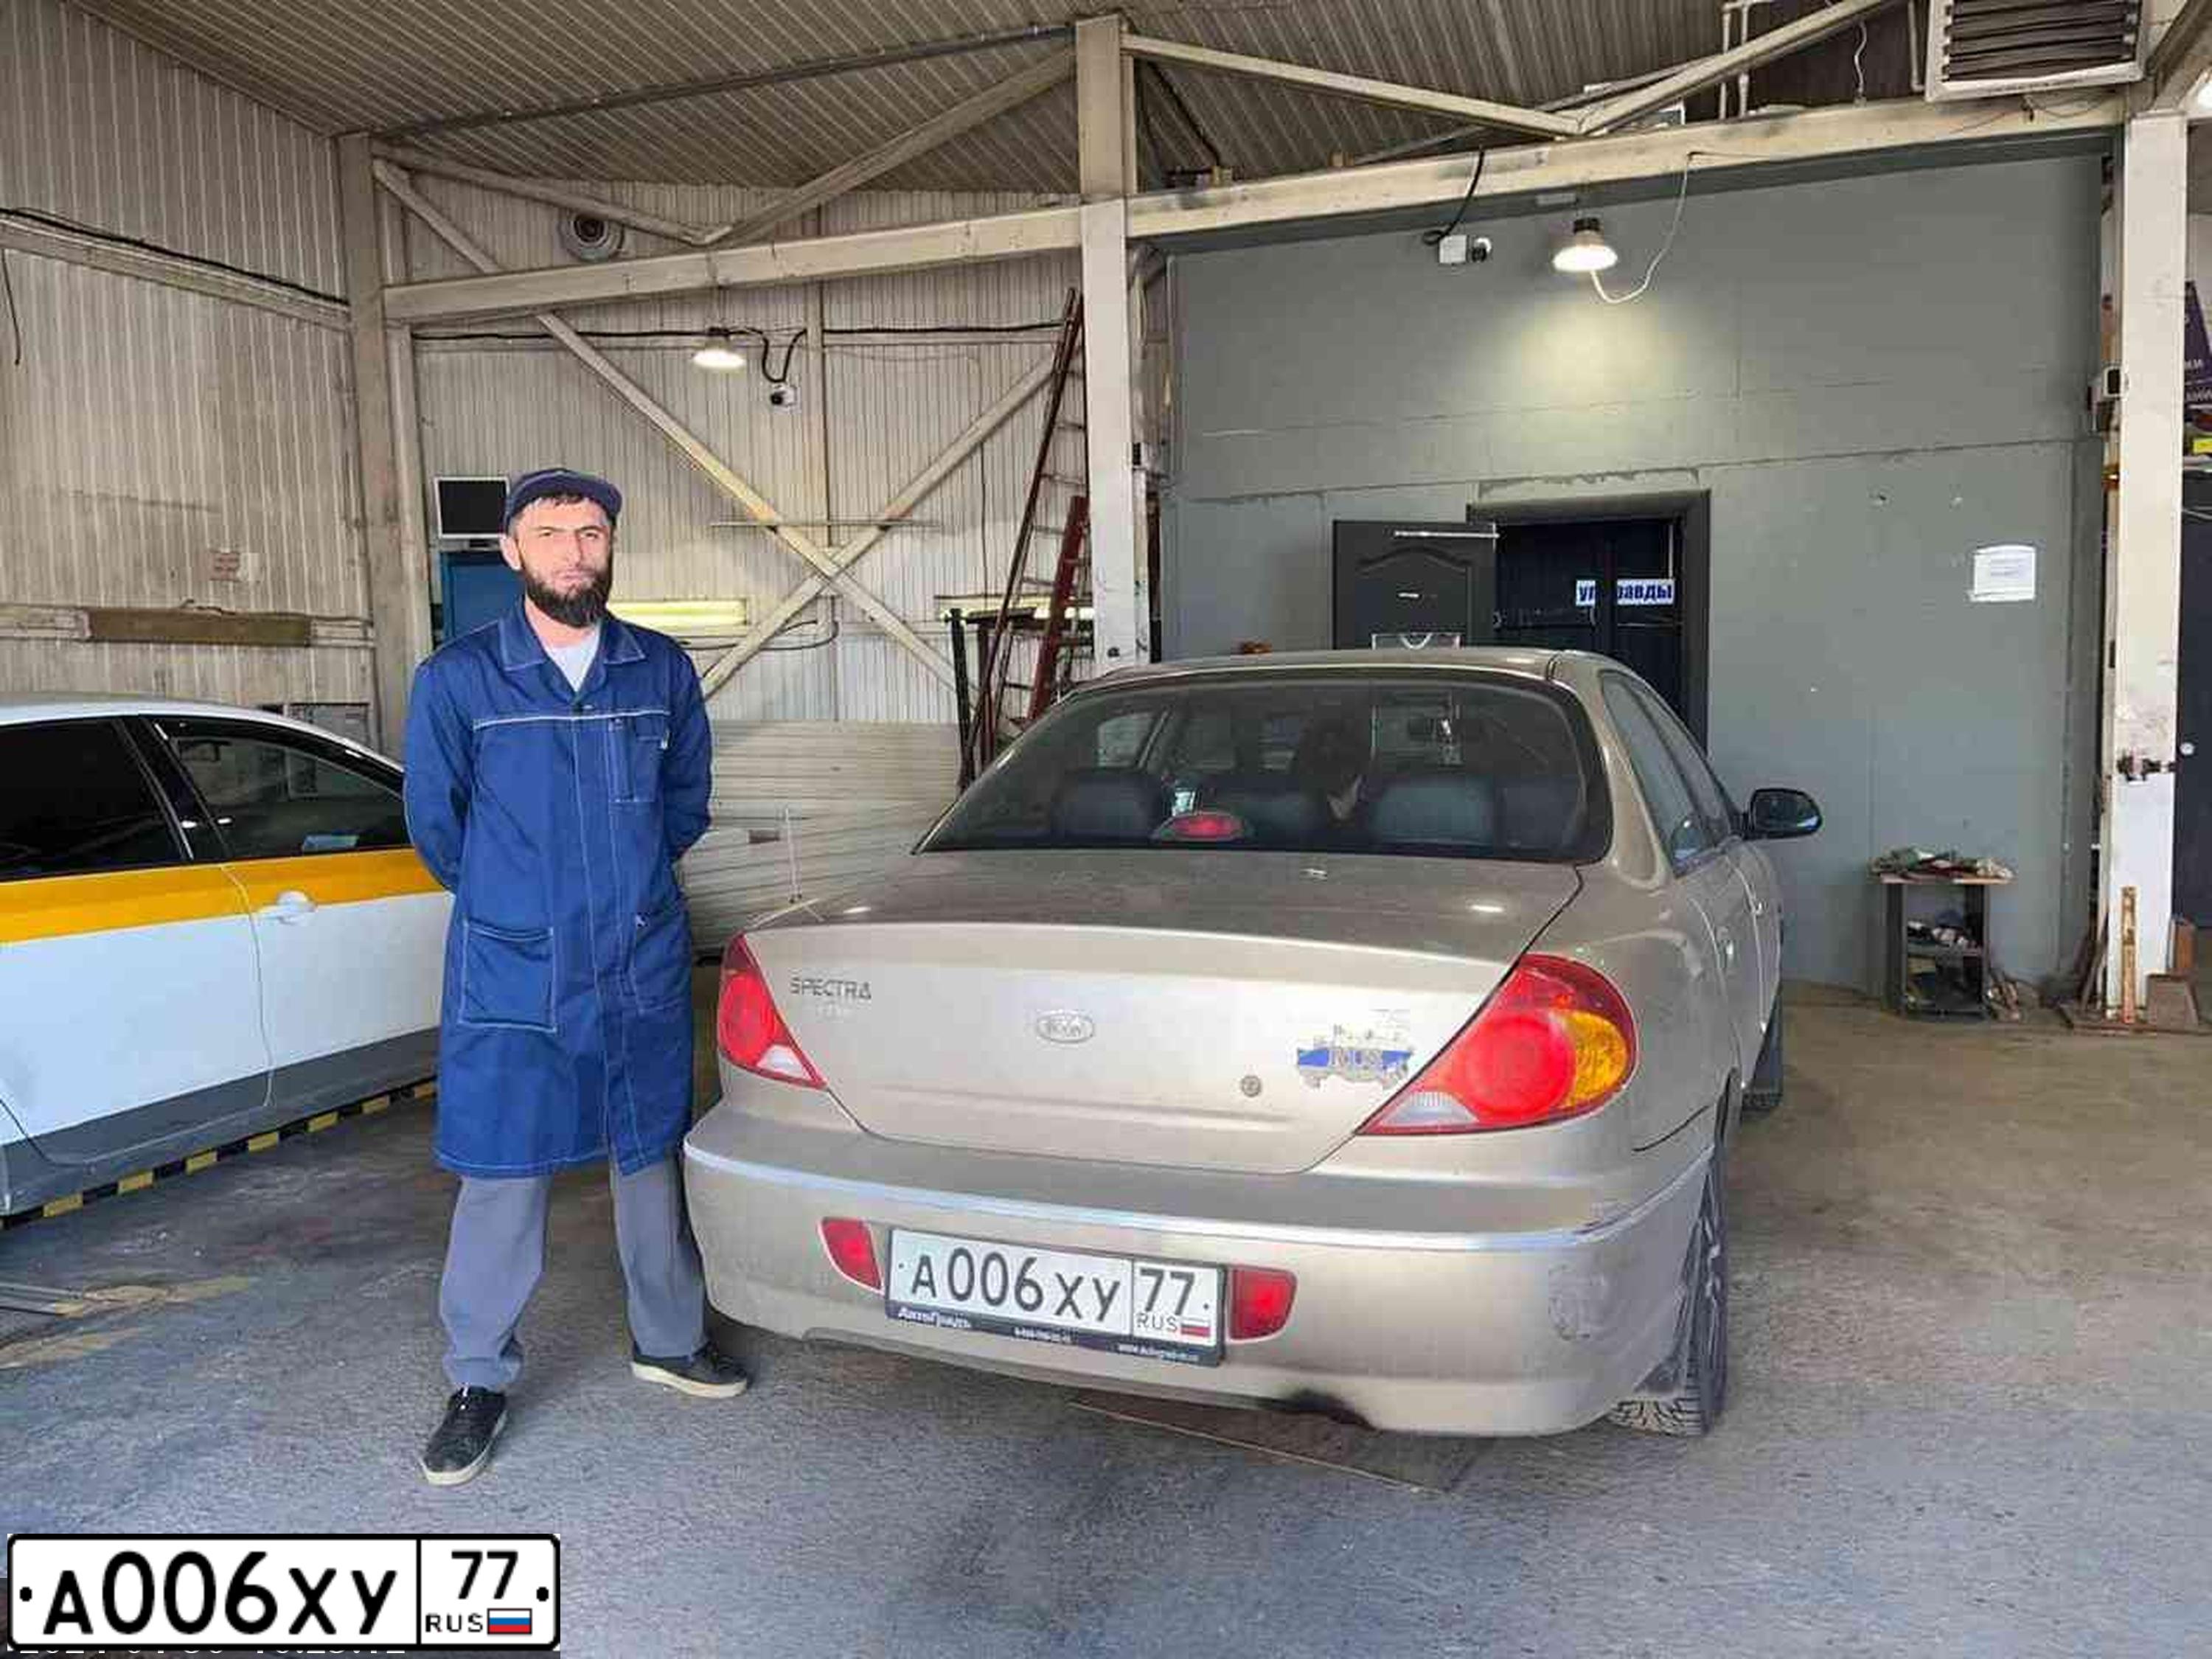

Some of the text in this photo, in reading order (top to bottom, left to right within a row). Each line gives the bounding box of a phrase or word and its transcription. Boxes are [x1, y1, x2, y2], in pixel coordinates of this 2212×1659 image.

[790, 975, 872, 1000] SPECTRA
[910, 1247, 1195, 1323] А006ХУ 77
[1137, 1312, 1178, 1334] RUS
